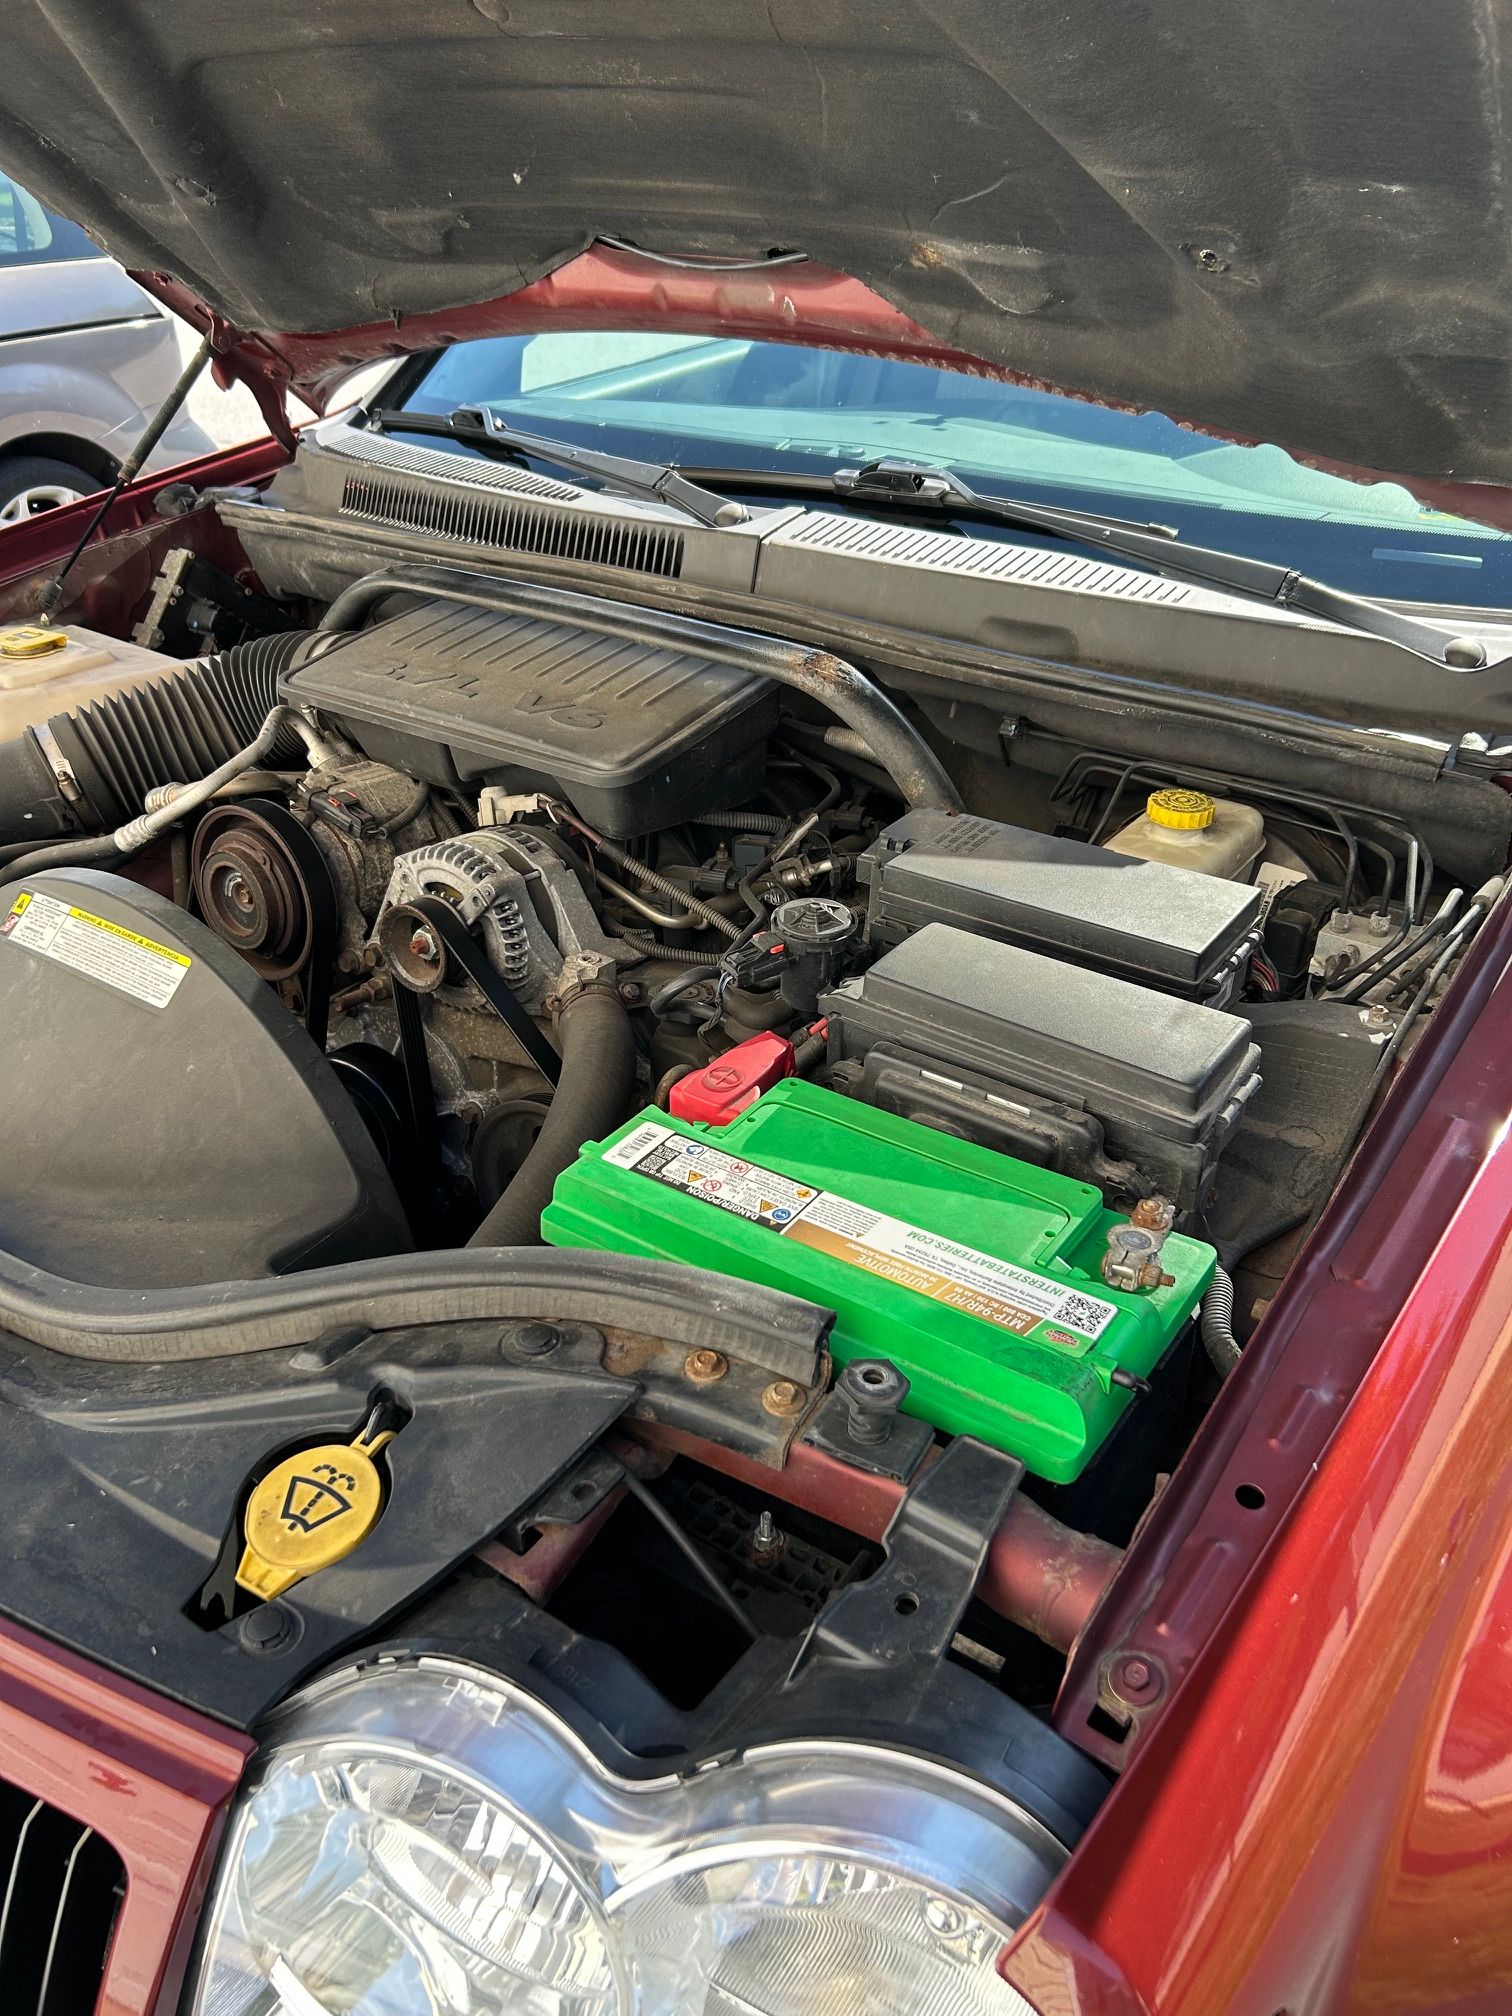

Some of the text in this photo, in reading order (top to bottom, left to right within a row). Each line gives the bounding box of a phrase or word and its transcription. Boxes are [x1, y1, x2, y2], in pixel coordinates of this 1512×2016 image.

[683, 1185, 761, 1220] DANGER/POISON
[851, 1252, 934, 1291] AUTOMOTIVE
[905, 1228, 1066, 1298] INTERSTATEBATTERIES.COM
[942, 1289, 1027, 1331] MTP-94R/H7
